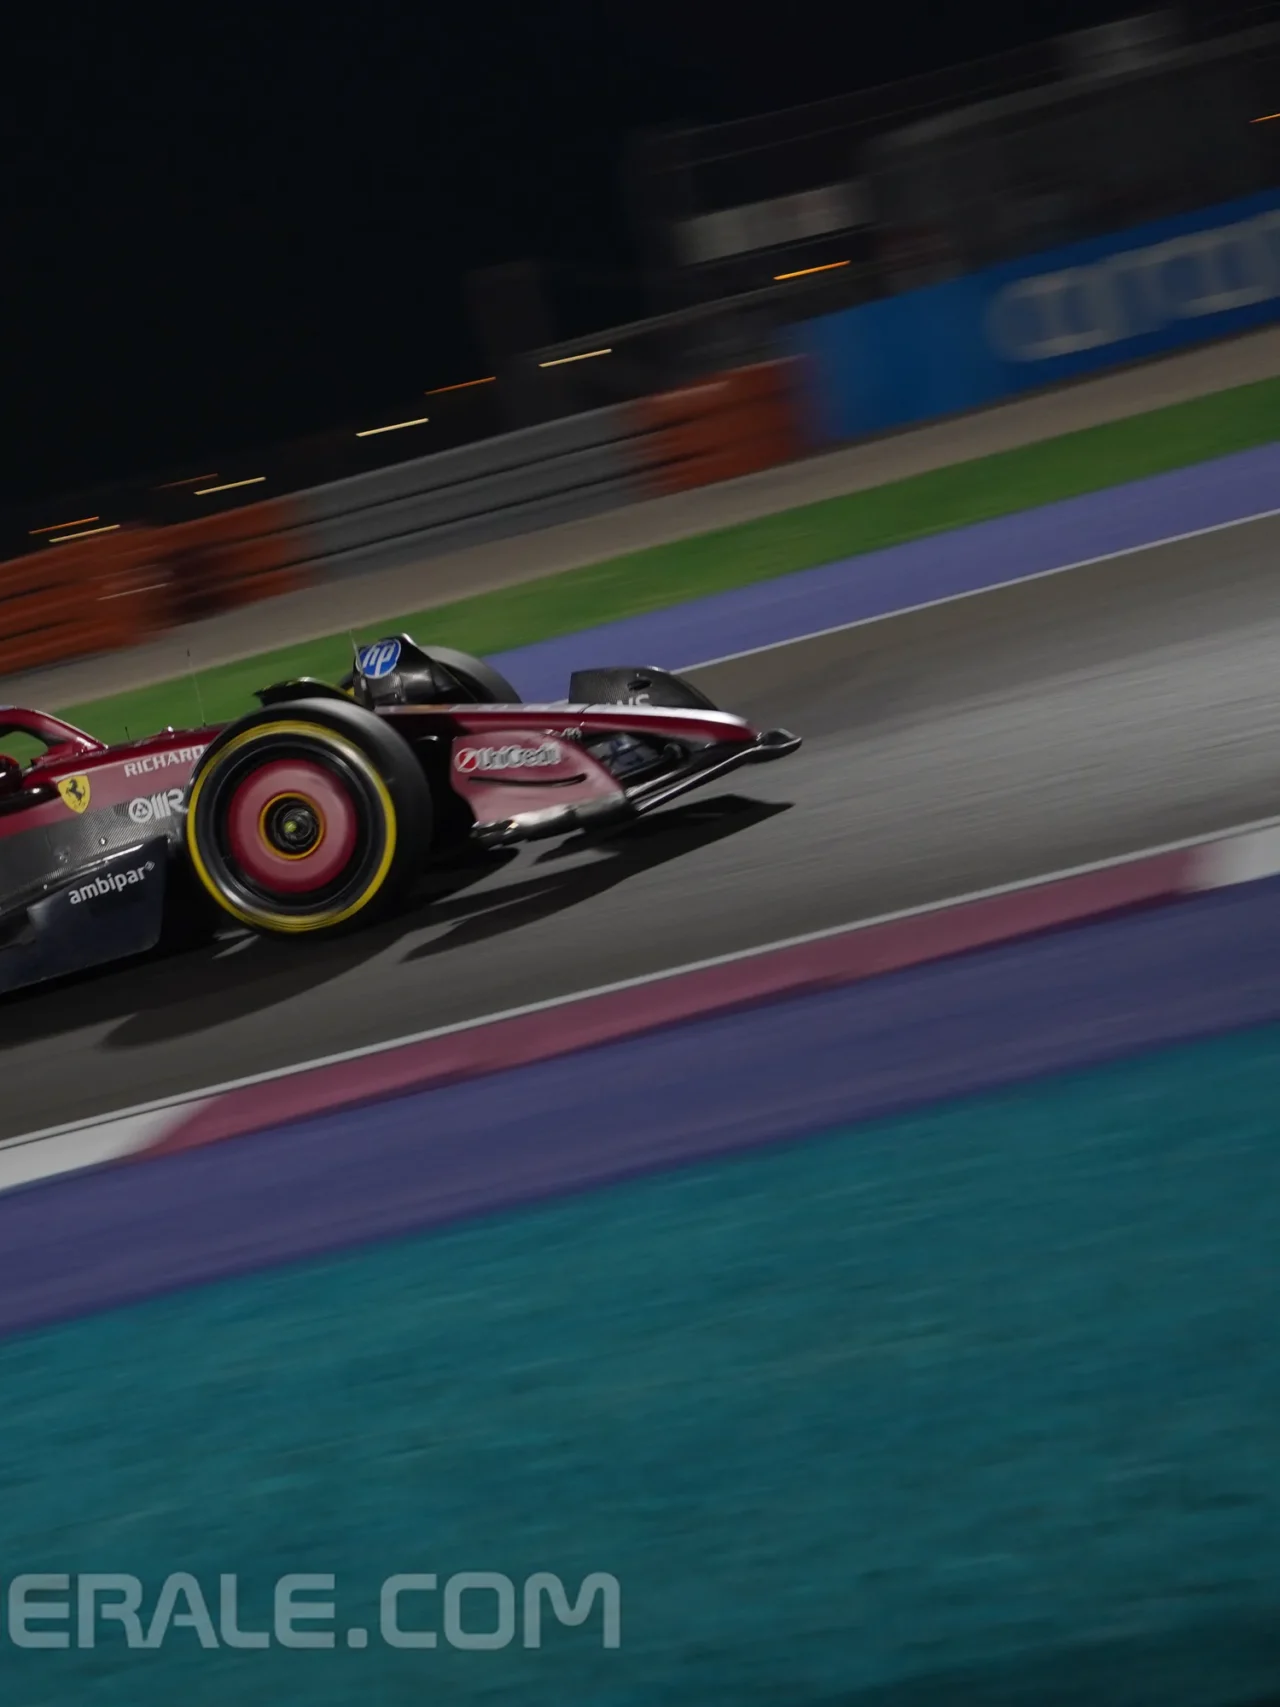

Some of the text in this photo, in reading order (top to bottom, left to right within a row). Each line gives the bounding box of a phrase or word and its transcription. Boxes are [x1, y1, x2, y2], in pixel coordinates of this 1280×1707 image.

[124, 744, 205, 777] RICHARD
[477, 742, 562, 770] UniCredit
[69, 866, 146, 904] ambipar
